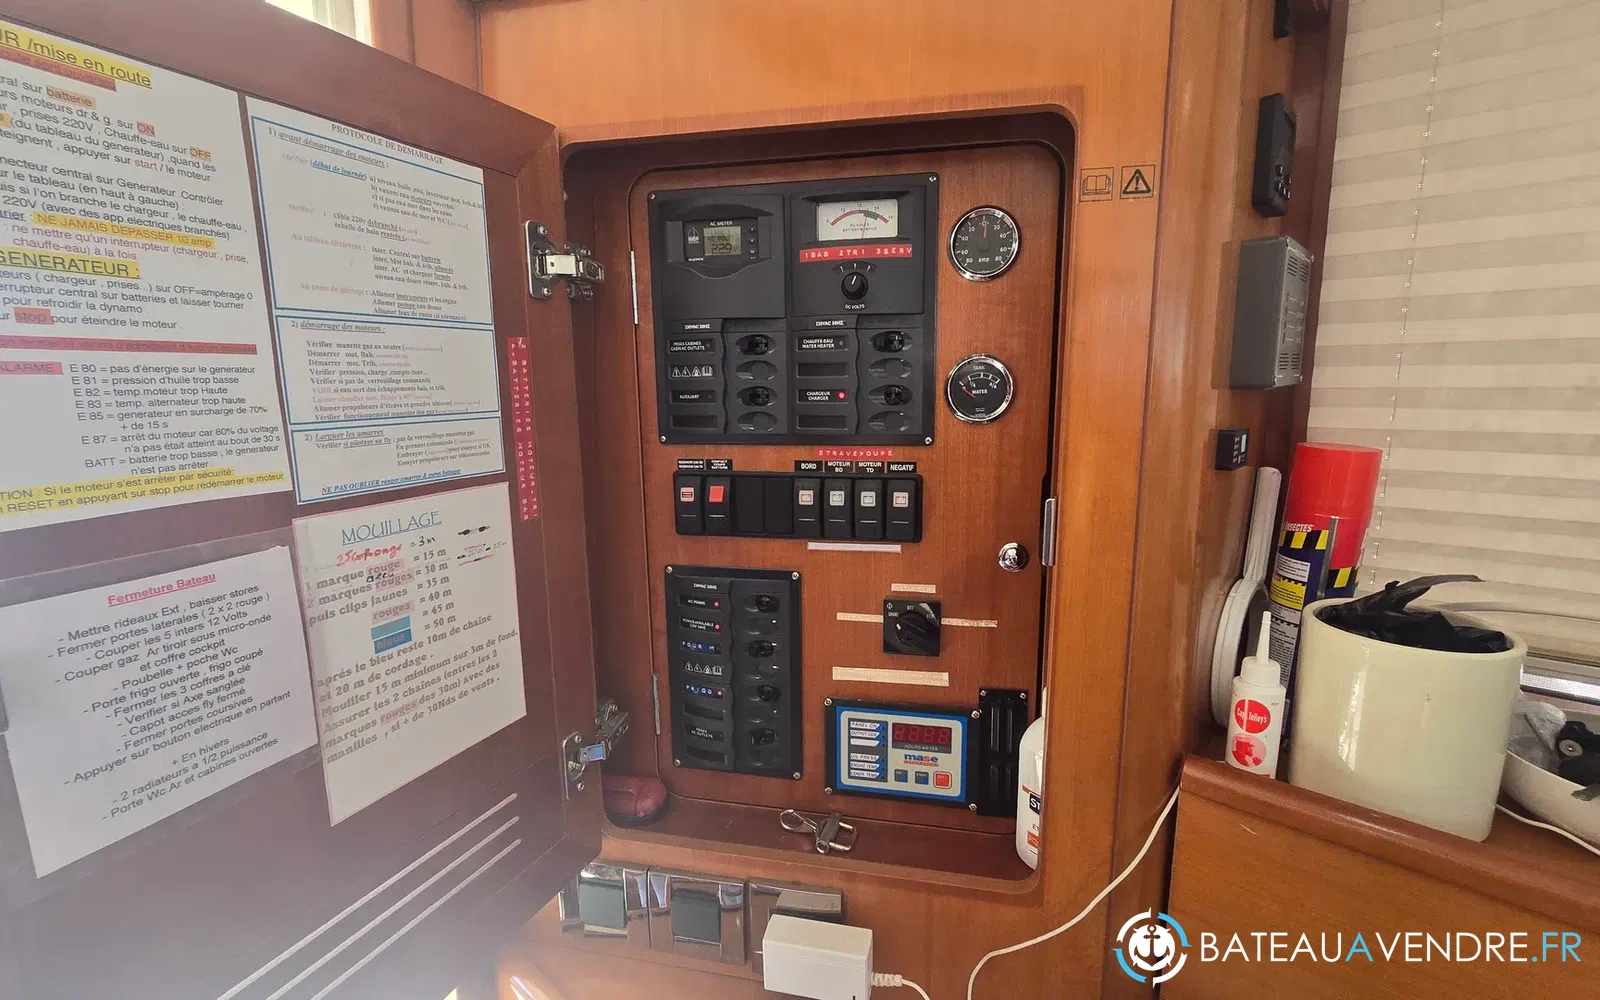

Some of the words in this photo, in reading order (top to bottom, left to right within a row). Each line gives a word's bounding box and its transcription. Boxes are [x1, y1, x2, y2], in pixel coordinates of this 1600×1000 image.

[28, 37, 77, 65] /mise
[84, 57, 104, 73] en
[110, 66, 151, 87] route
[21, 105, 59, 126] prises
[62, 117, 94, 133] 220V
[104, 128, 170, 151] Chauffe-eau
[172, 145, 188, 155] sur
[190, 148, 212, 162] OFF
[331, 124, 384, 146] PROTOCOLE
[385, 140, 396, 149] DE
[397, 143, 444, 164] DEMARRAGE
[345, 149, 356, 158] des
[38, 213, 58, 226] NE
[61, 218, 108, 233] JAMAIS
[112, 225, 174, 242] DEPASSER
[176, 236, 189, 244] 10
[191, 239, 212, 248] amp
[711, 243, 733, 254] 229
[3, 297, 33, 308] pour
[37, 300, 84, 311] refroidir
[87, 302, 97, 311] la
[100, 305, 143, 315] dynamo
[300, 322, 340, 333] démarrage
[356, 325, 381, 333] moteurs
[70, 365, 78, 373] E
[80, 365, 96, 373] 80
[110, 366, 130, 375] pas
[132, 363, 179, 376] d'énergie
[182, 366, 196, 374] sur
[199, 365, 207, 374] le
[209, 366, 255, 376] generateur
[522, 360, 531, 431] BATTERIES
[357, 430, 384, 438] amarres
[518, 443, 526, 488] MOTEUR
[342, 511, 441, 543] MOUILLAGE
[108, 583, 173, 605] Fermeture
[177, 573, 216, 589] Bateau
[316, 571, 365, 590] marque
[368, 560, 401, 576] rouge
[423, 551, 434, 561] 15
[437, 549, 447, 557] m
[68, 625, 111, 642] Mettre
[115, 612, 158, 630] rideaux
[161, 605, 180, 617] Ext
[189, 594, 227, 609] baisser
[230, 584, 259, 599] stores
[309, 613, 336, 627] puis
[339, 601, 368, 617] clips
[371, 588, 408, 607] jaunes
[426, 577, 438, 587] 35
[64, 662, 114, 681] Couper
[118, 653, 140, 668] gaz
[147, 647, 160, 657] Ar
[163, 639, 187, 651] tiroir
[191, 631, 215, 643] sous
[218, 613, 272, 635] micro-onde
[94, 641, 141, 660] Couper
[145, 635, 161, 646] les
[164, 631, 171, 640] 5
[174, 623, 204, 636] inters
[208, 616, 219, 626] 12
[222, 610, 248, 622] Volts
[356, 663, 366, 673] le
[370, 653, 394, 667] bleu
[397, 642, 424, 657] reste
[428, 632, 447, 644] 10m
[449, 625, 461, 636] de
[463, 615, 492, 631] chaîne
[140, 663, 152, 672] et
[155, 652, 186, 666] coffre
[189, 639, 226, 658] cockpit
[130, 716, 166, 737] Capot
[168, 706, 201, 721] acces
[203, 697, 214, 709] fly
[217, 687, 246, 702] fermé
[74, 757, 128, 784] Appuyer
[131, 748, 150, 761] sur
[153, 731, 191, 751] bouton
[194, 711, 243, 734] electrique
[245, 705, 257, 714] en
[260, 691, 291, 709] partant
[904, 754, 938, 762] mase
